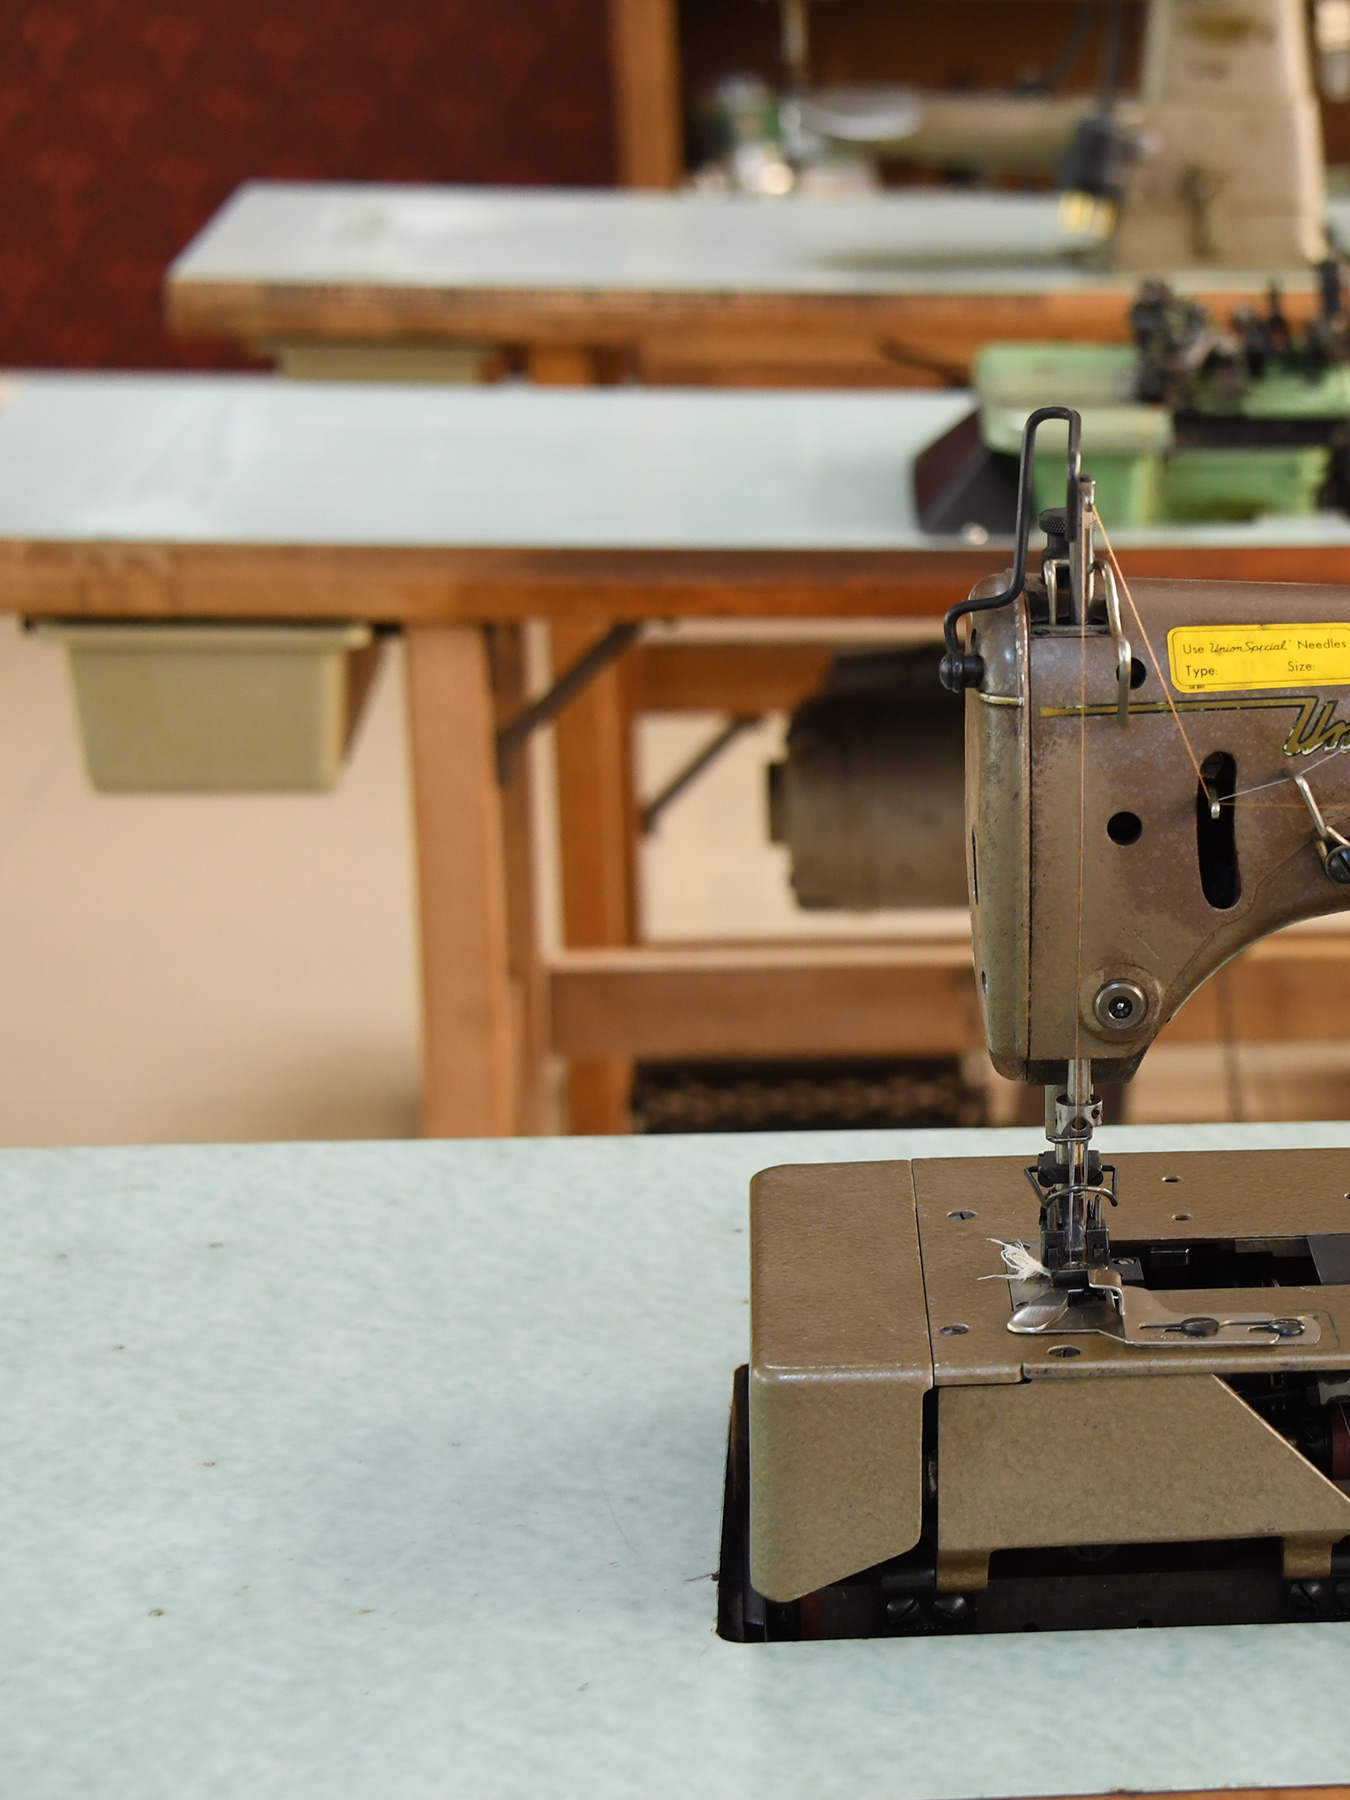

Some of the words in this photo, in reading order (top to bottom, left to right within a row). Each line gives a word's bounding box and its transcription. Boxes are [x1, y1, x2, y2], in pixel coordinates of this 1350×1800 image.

[1182, 644, 1205, 655] Use
[1209, 642, 1243, 654] Union
[1244, 639, 1287, 654] Special
[1297, 638, 1347, 650] Needles
